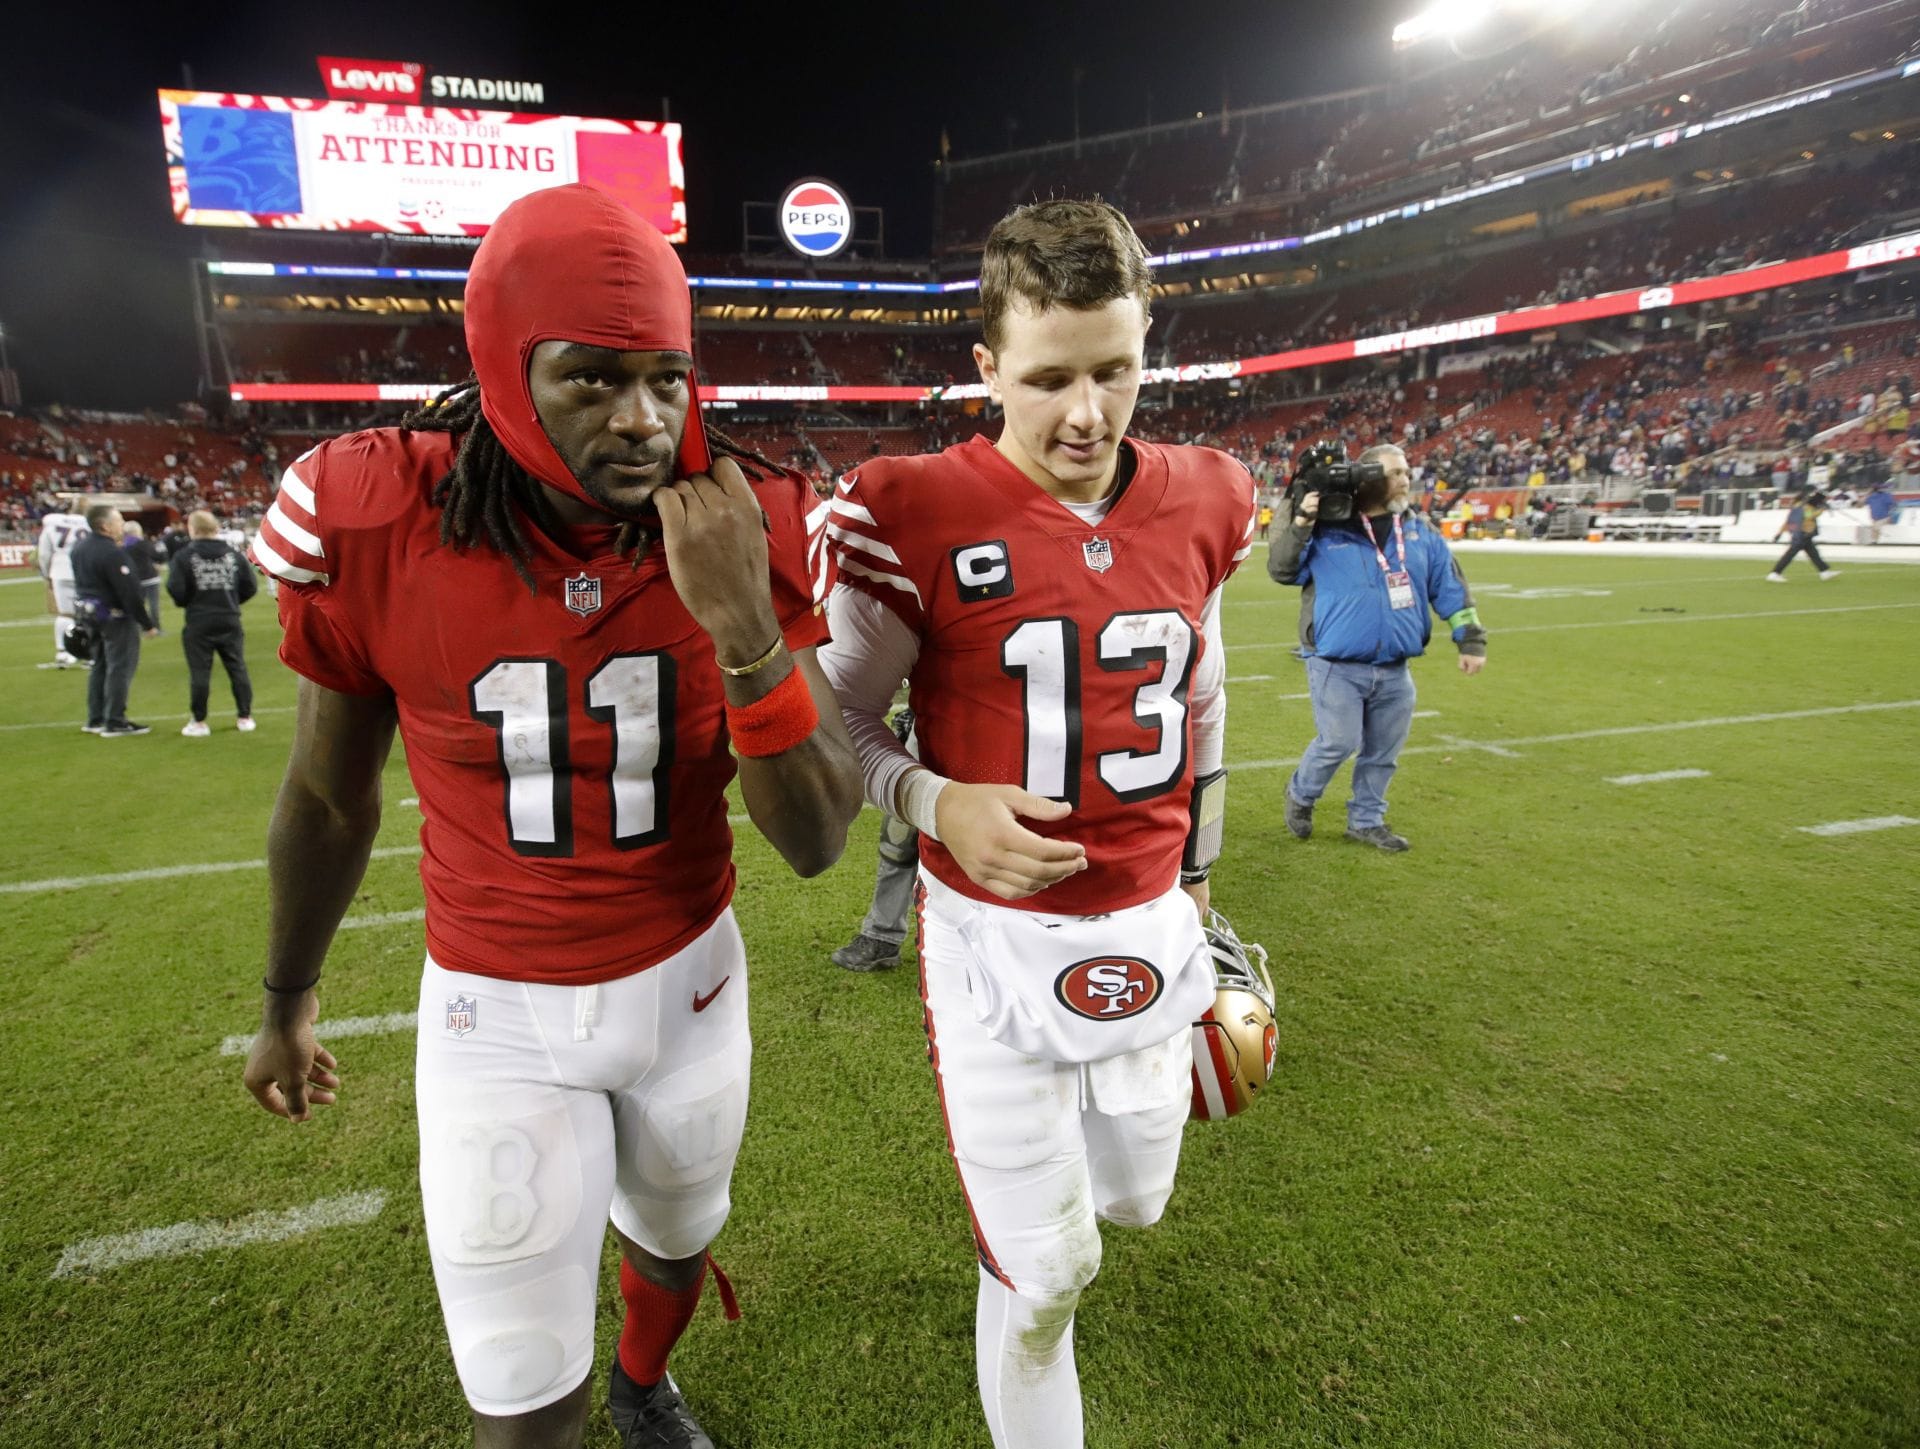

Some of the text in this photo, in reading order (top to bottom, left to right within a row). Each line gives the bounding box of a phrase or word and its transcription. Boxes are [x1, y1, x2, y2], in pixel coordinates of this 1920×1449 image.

[431, 75, 545, 104] STADIUM
[373, 116, 501, 139] THANKS FOR
[318, 133, 554, 173] ATTENDING
[788, 211, 844, 227] PEPSI
[955, 544, 1008, 588] C
[1089, 552, 1109, 567] NFL
[571, 591, 595, 609] NFL
[1001, 610, 1196, 804] 13
[470, 651, 675, 855] 11
[450, 1013, 471, 1030] NFL
